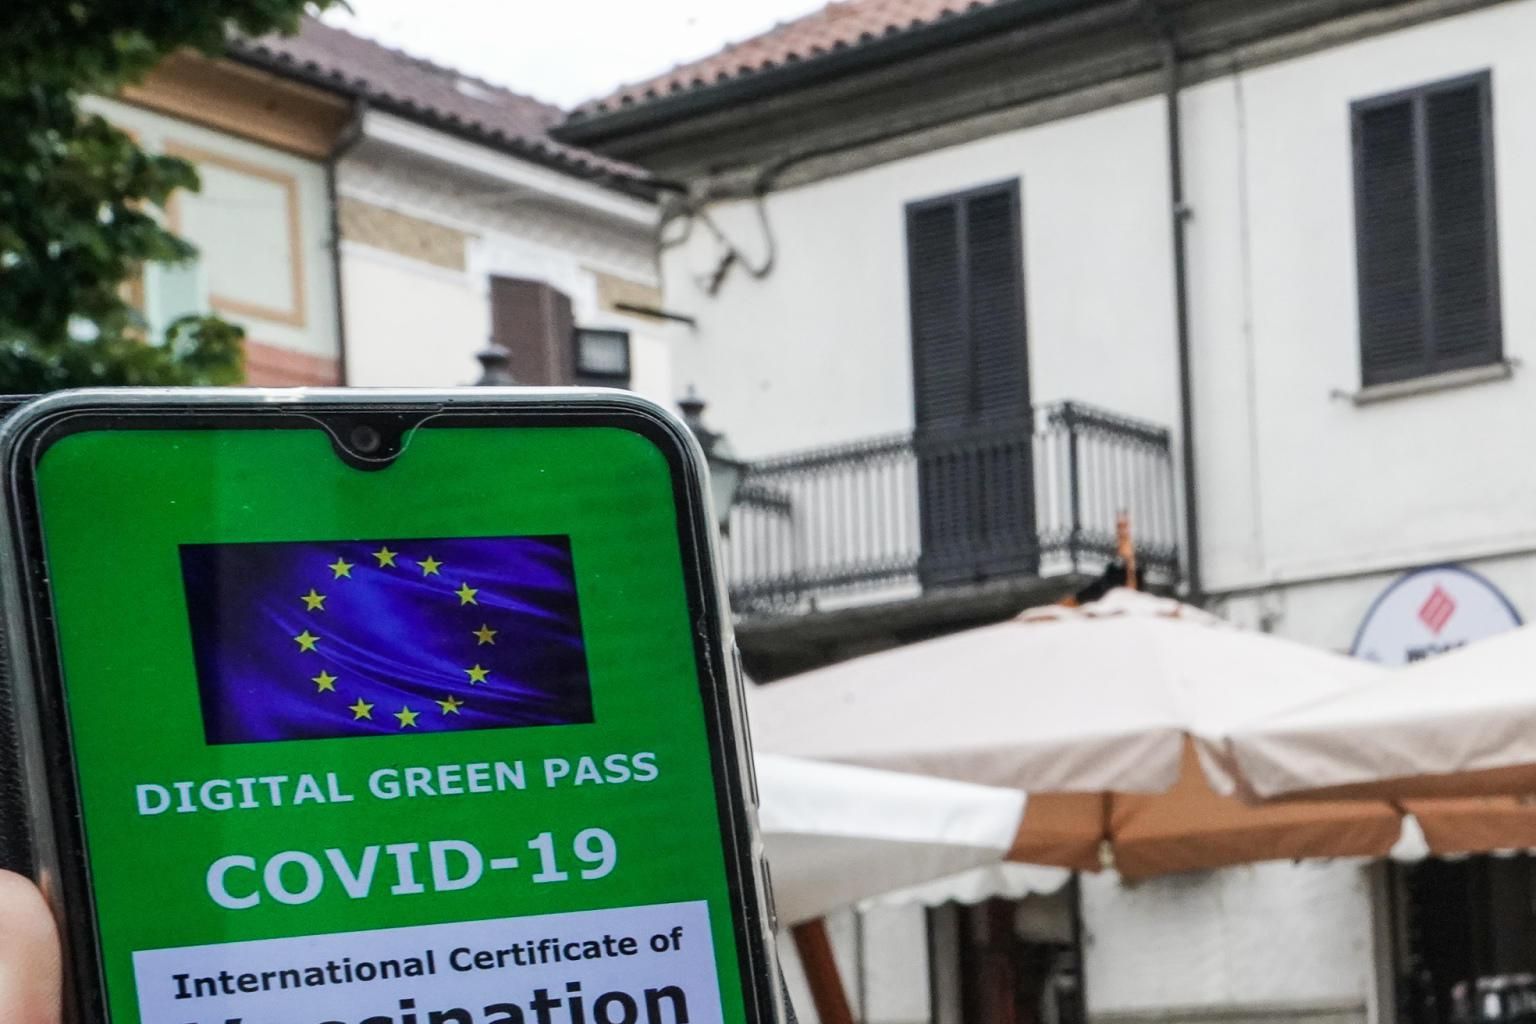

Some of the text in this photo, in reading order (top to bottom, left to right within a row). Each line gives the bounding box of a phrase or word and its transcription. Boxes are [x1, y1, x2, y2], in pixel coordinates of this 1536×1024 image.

[135, 751, 660, 816] DIGITAL GREEN PASS
[205, 827, 619, 910] COVID-19
[172, 926, 684, 999] International Certificate of
